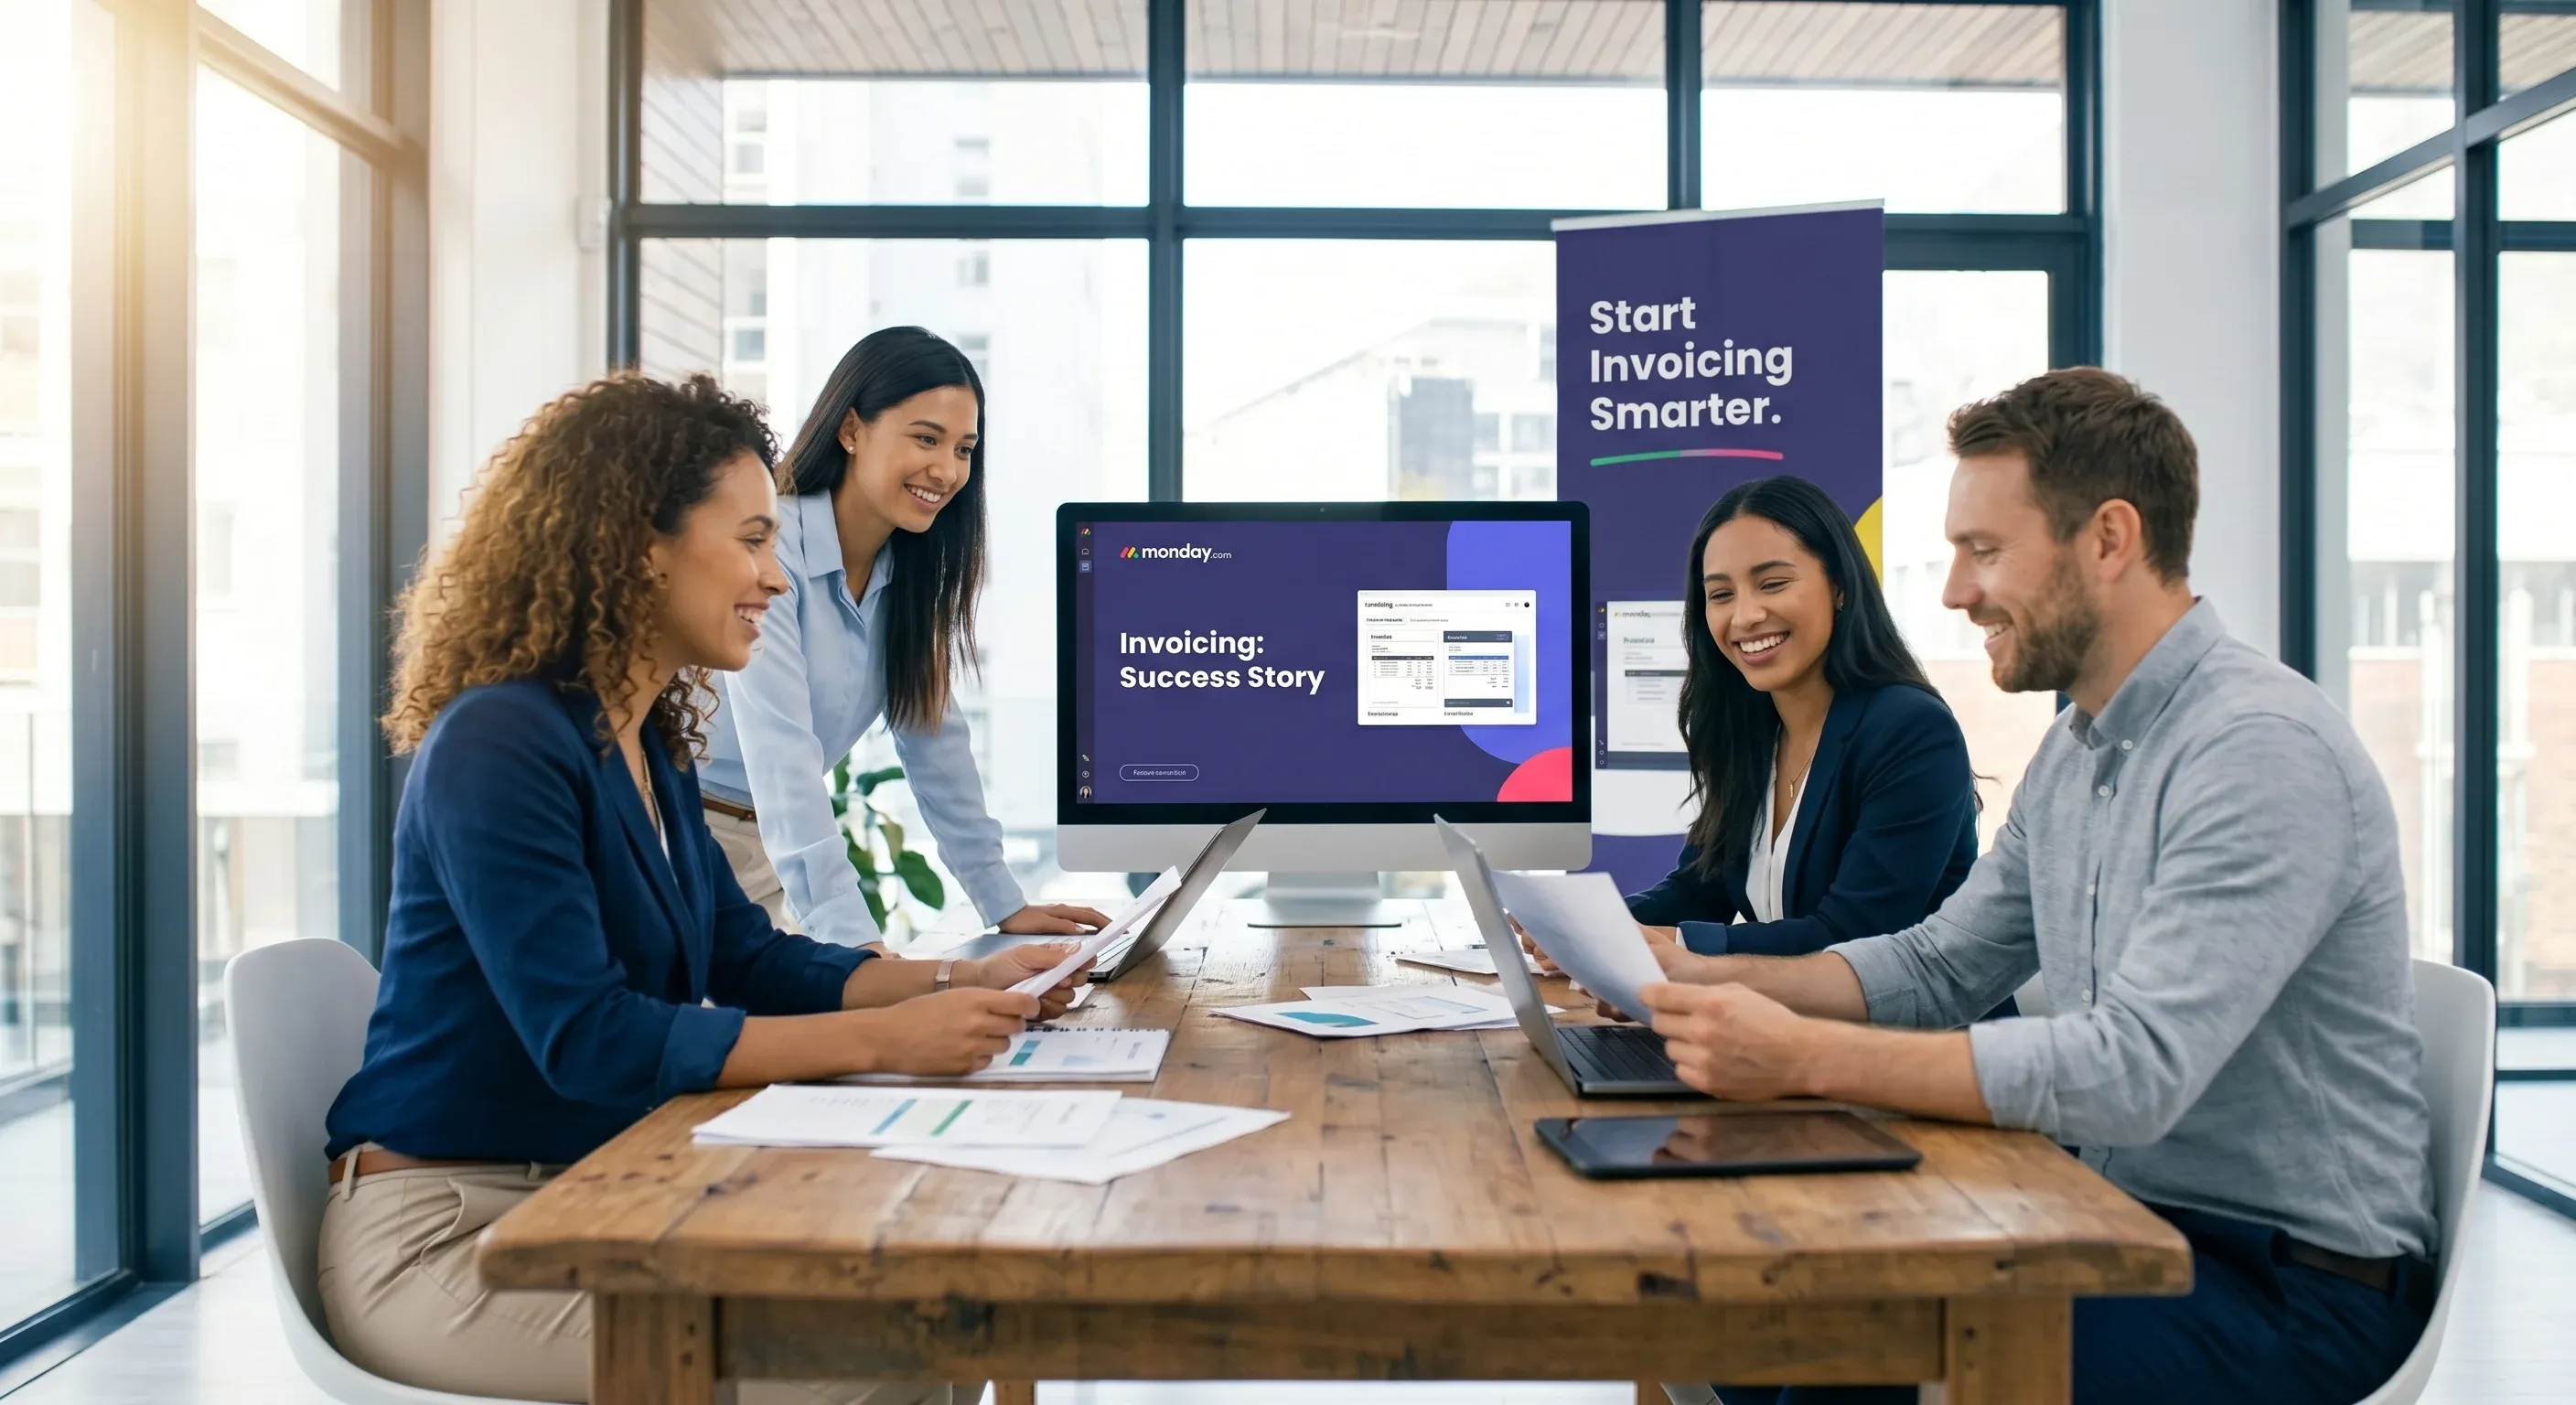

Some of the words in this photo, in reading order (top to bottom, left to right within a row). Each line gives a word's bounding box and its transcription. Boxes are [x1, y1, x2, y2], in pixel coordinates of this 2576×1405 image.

[1590, 296, 1696, 335] Start
[1591, 338, 1793, 387] Invoicing
[1590, 393, 1782, 431] Smarter.
[1143, 542, 1232, 563] monday.com
[1120, 629, 1264, 661] Invoicing:
[1120, 666, 1240, 689] Success
[1247, 665, 1326, 695] Story
